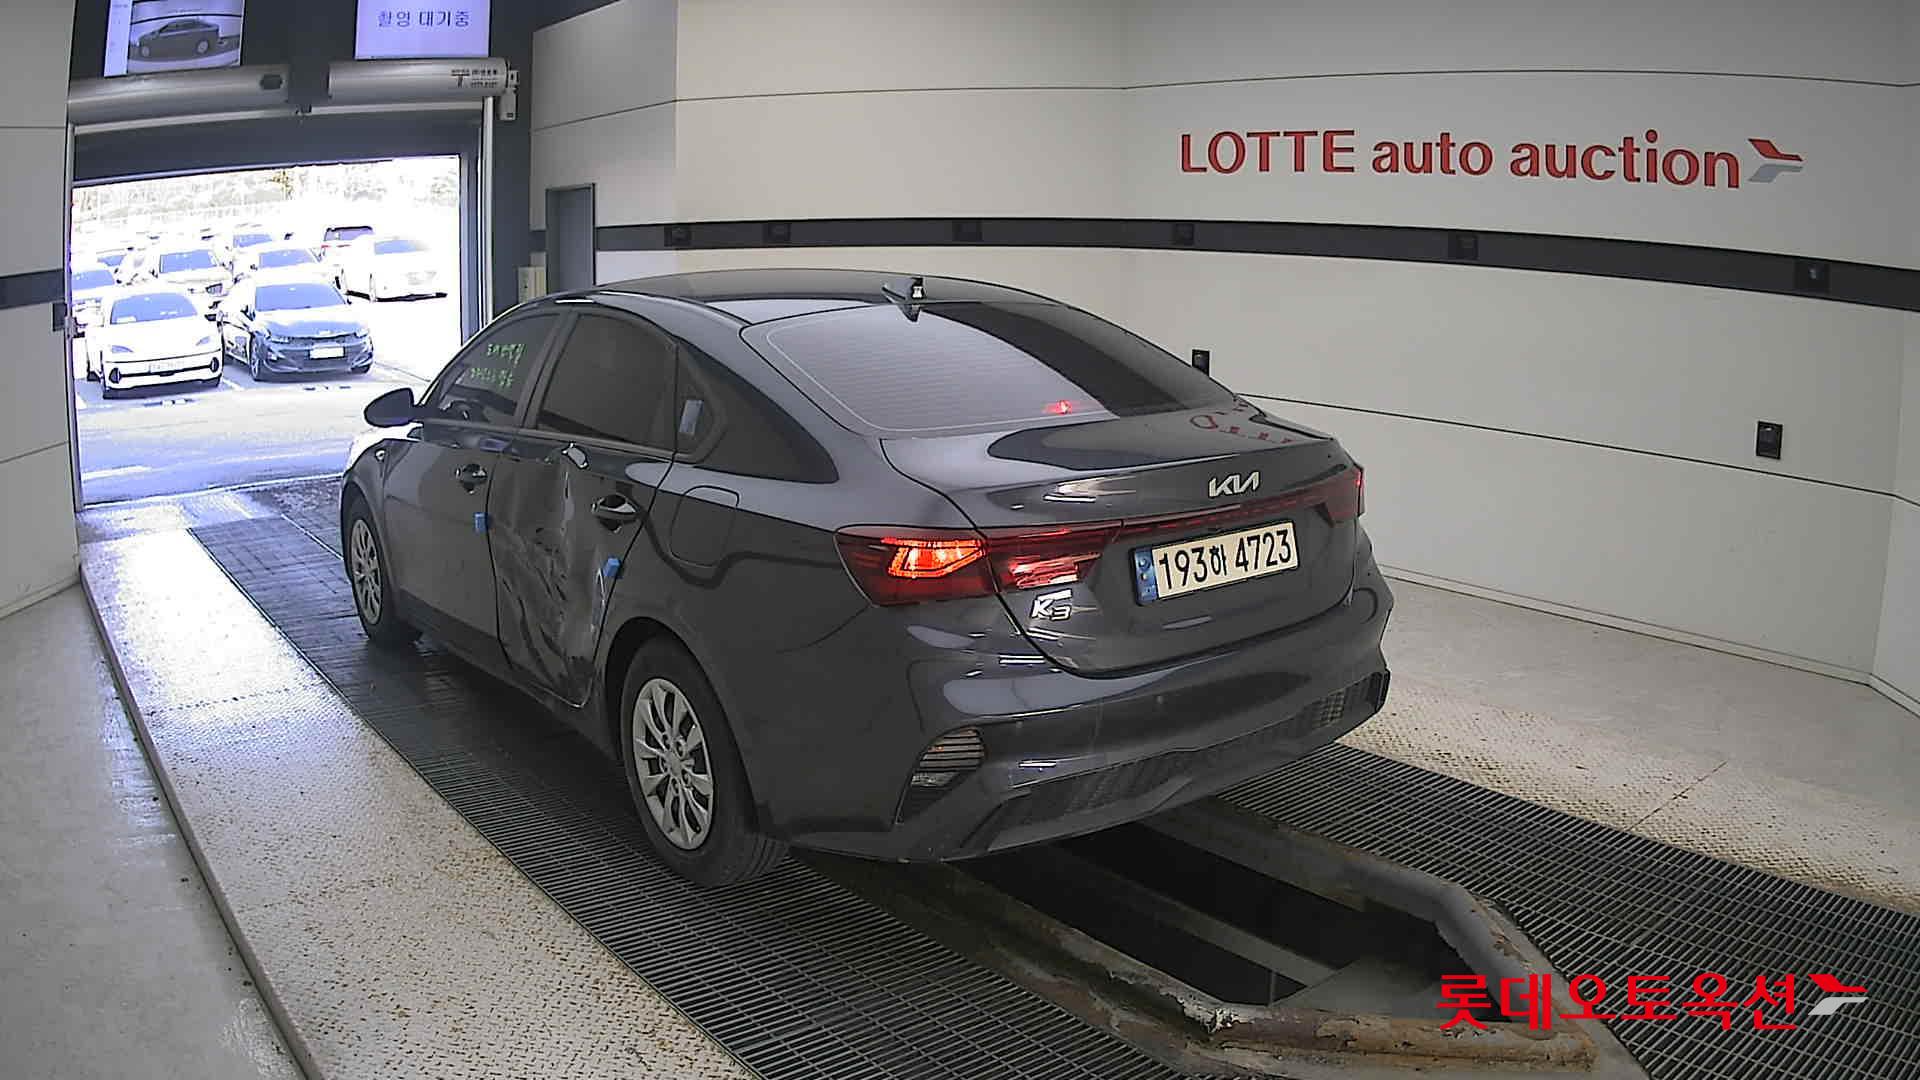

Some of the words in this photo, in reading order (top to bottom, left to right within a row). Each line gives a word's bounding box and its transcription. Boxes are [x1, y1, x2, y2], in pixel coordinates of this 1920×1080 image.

[418, 10, 470, 27] 대기중
[1181, 129, 1355, 174] LOTTE
[1371, 131, 1493, 176] auto
[1509, 129, 1740, 189] auction
[1158, 543, 1228, 591] 193하
[1234, 528, 1292, 573] 4723
[1030, 588, 1073, 620] K3
